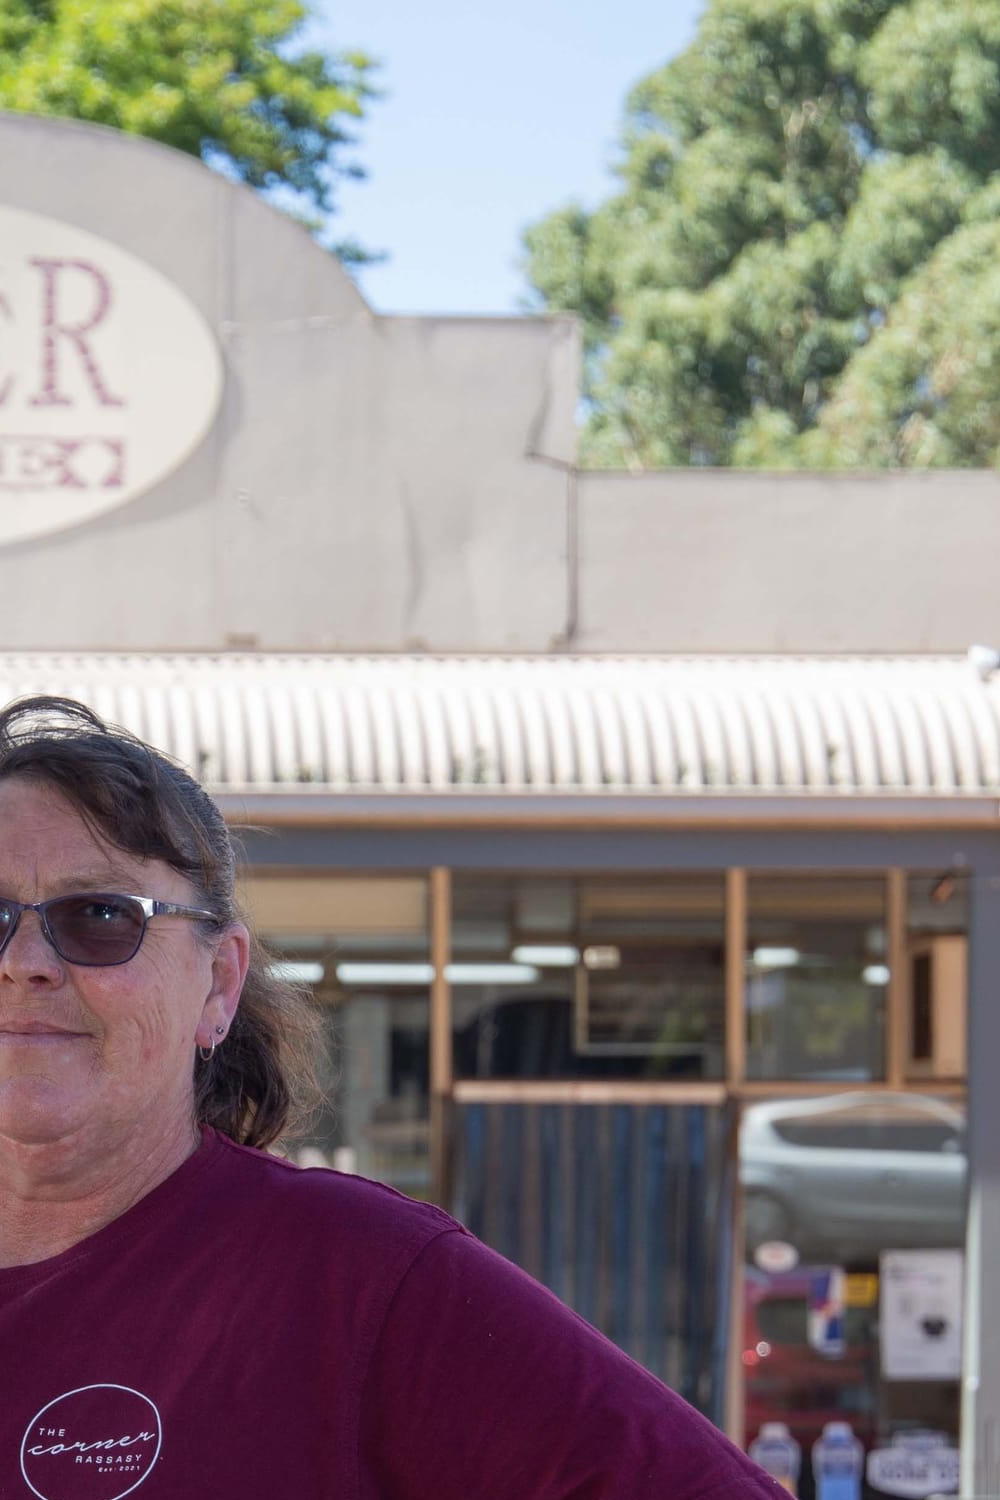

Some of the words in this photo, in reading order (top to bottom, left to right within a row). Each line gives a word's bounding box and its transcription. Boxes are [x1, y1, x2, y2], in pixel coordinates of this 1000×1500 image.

[38, 1427, 67, 1437] THE
[27, 1431, 156, 1455] corner
[75, 1454, 142, 1464] RASSASY
